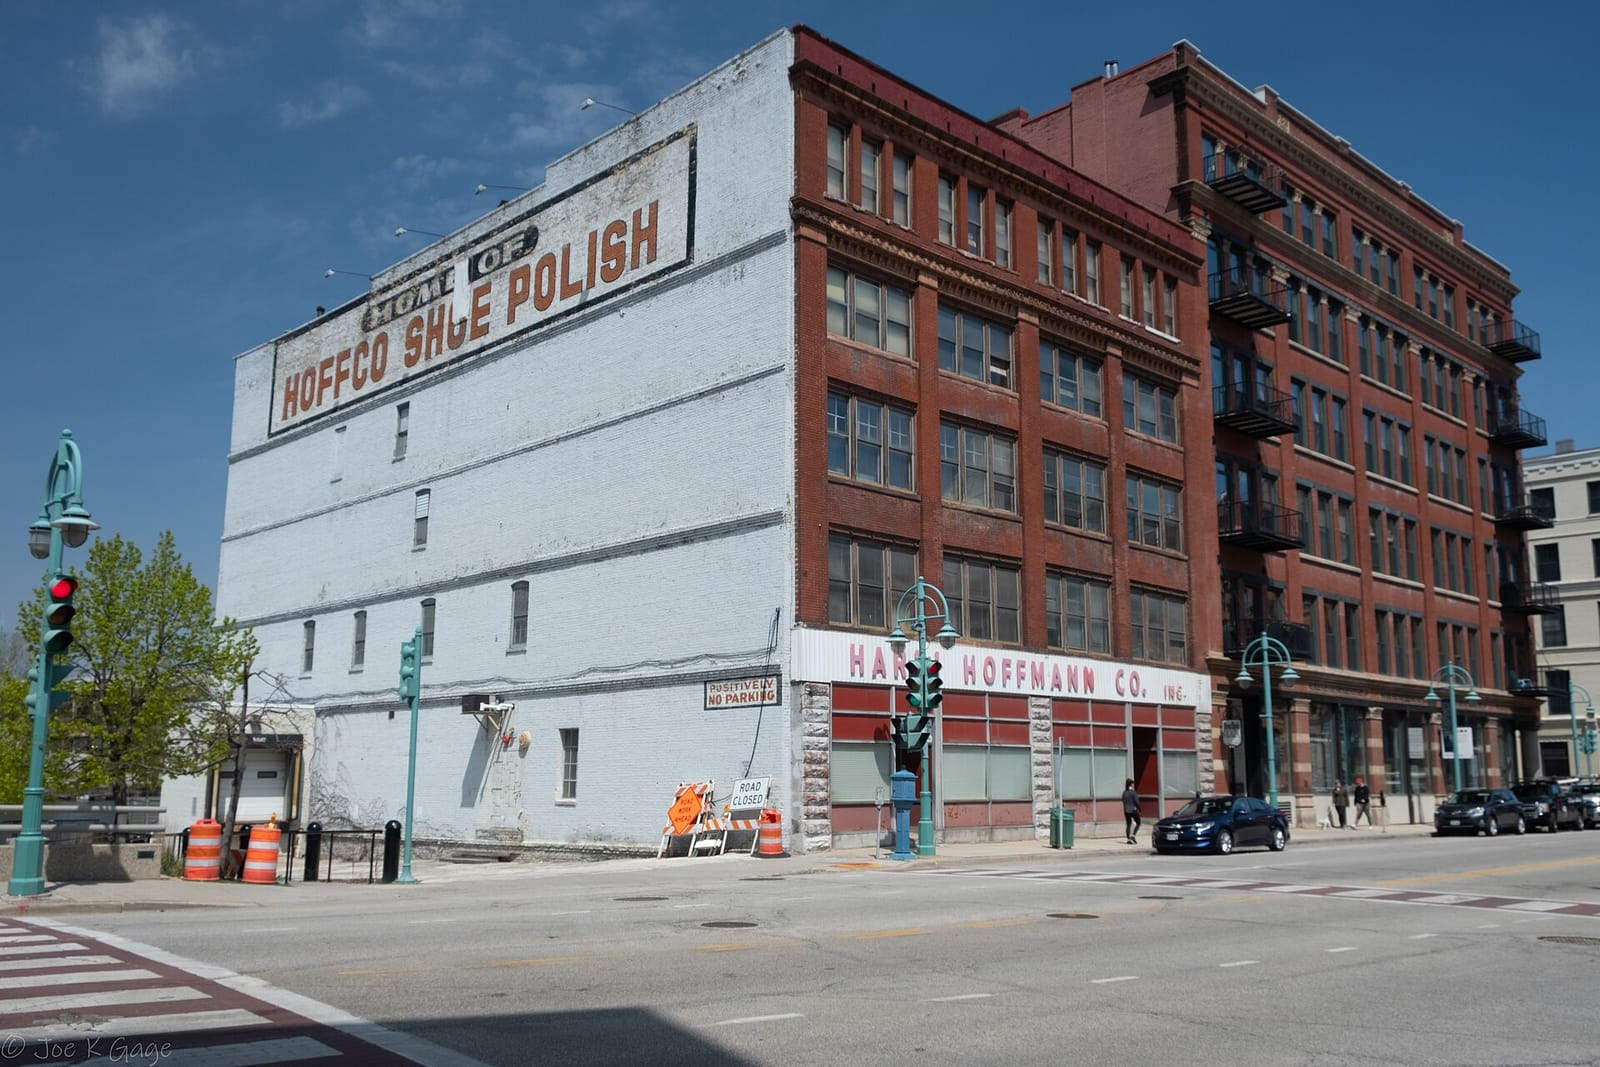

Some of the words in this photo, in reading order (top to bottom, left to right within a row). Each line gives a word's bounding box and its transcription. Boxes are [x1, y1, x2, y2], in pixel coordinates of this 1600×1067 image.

[477, 231, 525, 275] OF
[282, 331, 389, 420] HOFFCO
[404, 281, 492, 368] SHOE
[507, 200, 659, 325] POLISH
[850, 643, 940, 681] HAR
[963, 654, 1096, 694] HOFFMANN
[1115, 668, 1147, 698] CO.
[709, 679, 774, 693] POSITIVELY
[708, 694, 722, 705] NO
[725, 690, 775, 704] PARKING
[740, 782, 761, 793] ROAD
[732, 794, 763, 806] CLOSED
